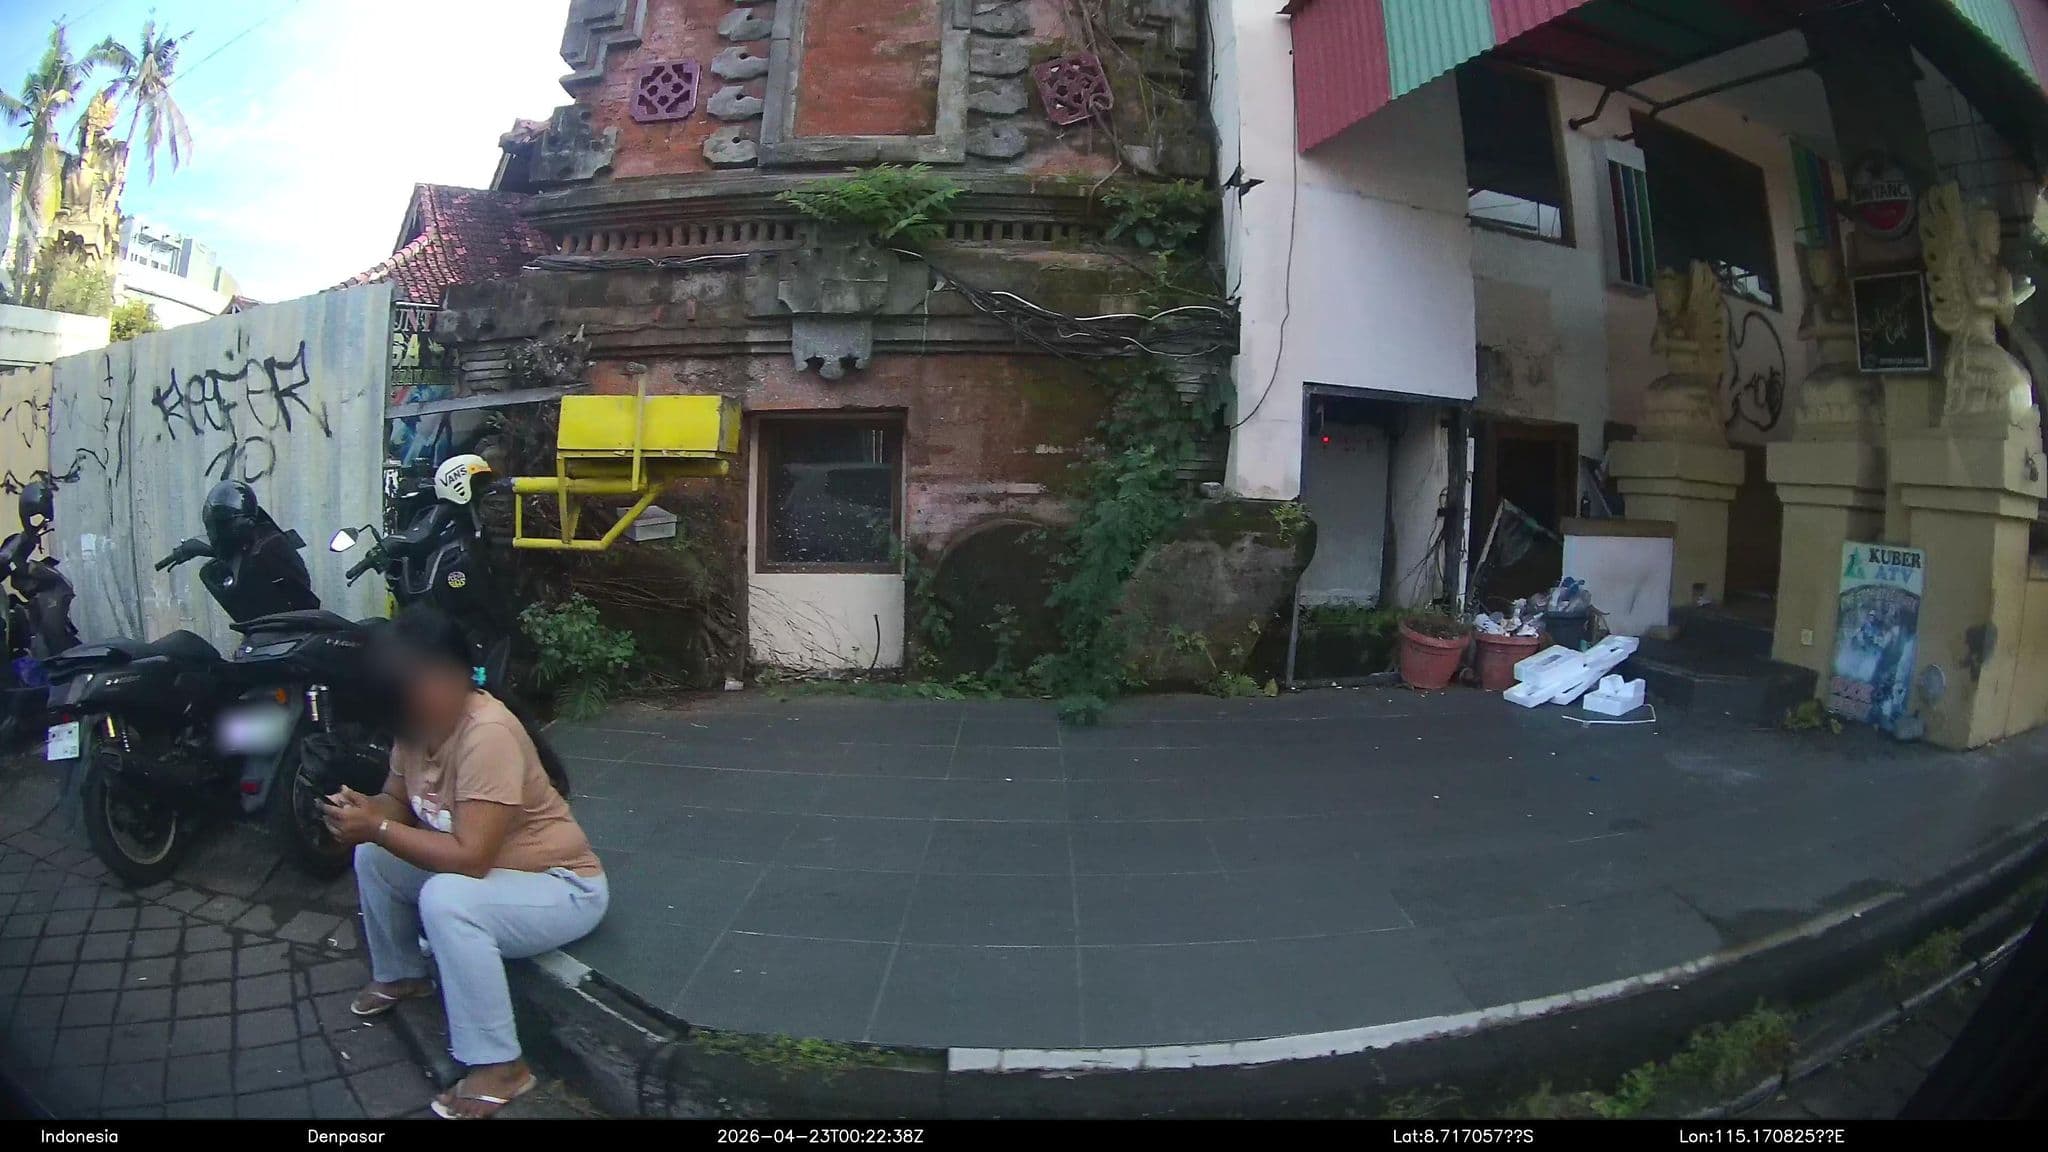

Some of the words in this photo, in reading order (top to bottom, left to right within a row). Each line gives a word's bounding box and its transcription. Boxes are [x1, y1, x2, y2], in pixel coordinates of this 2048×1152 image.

[440, 464, 467, 487] VANS
[1868, 548, 1921, 568] KUBER
[1875, 565, 1913, 584] ATV
